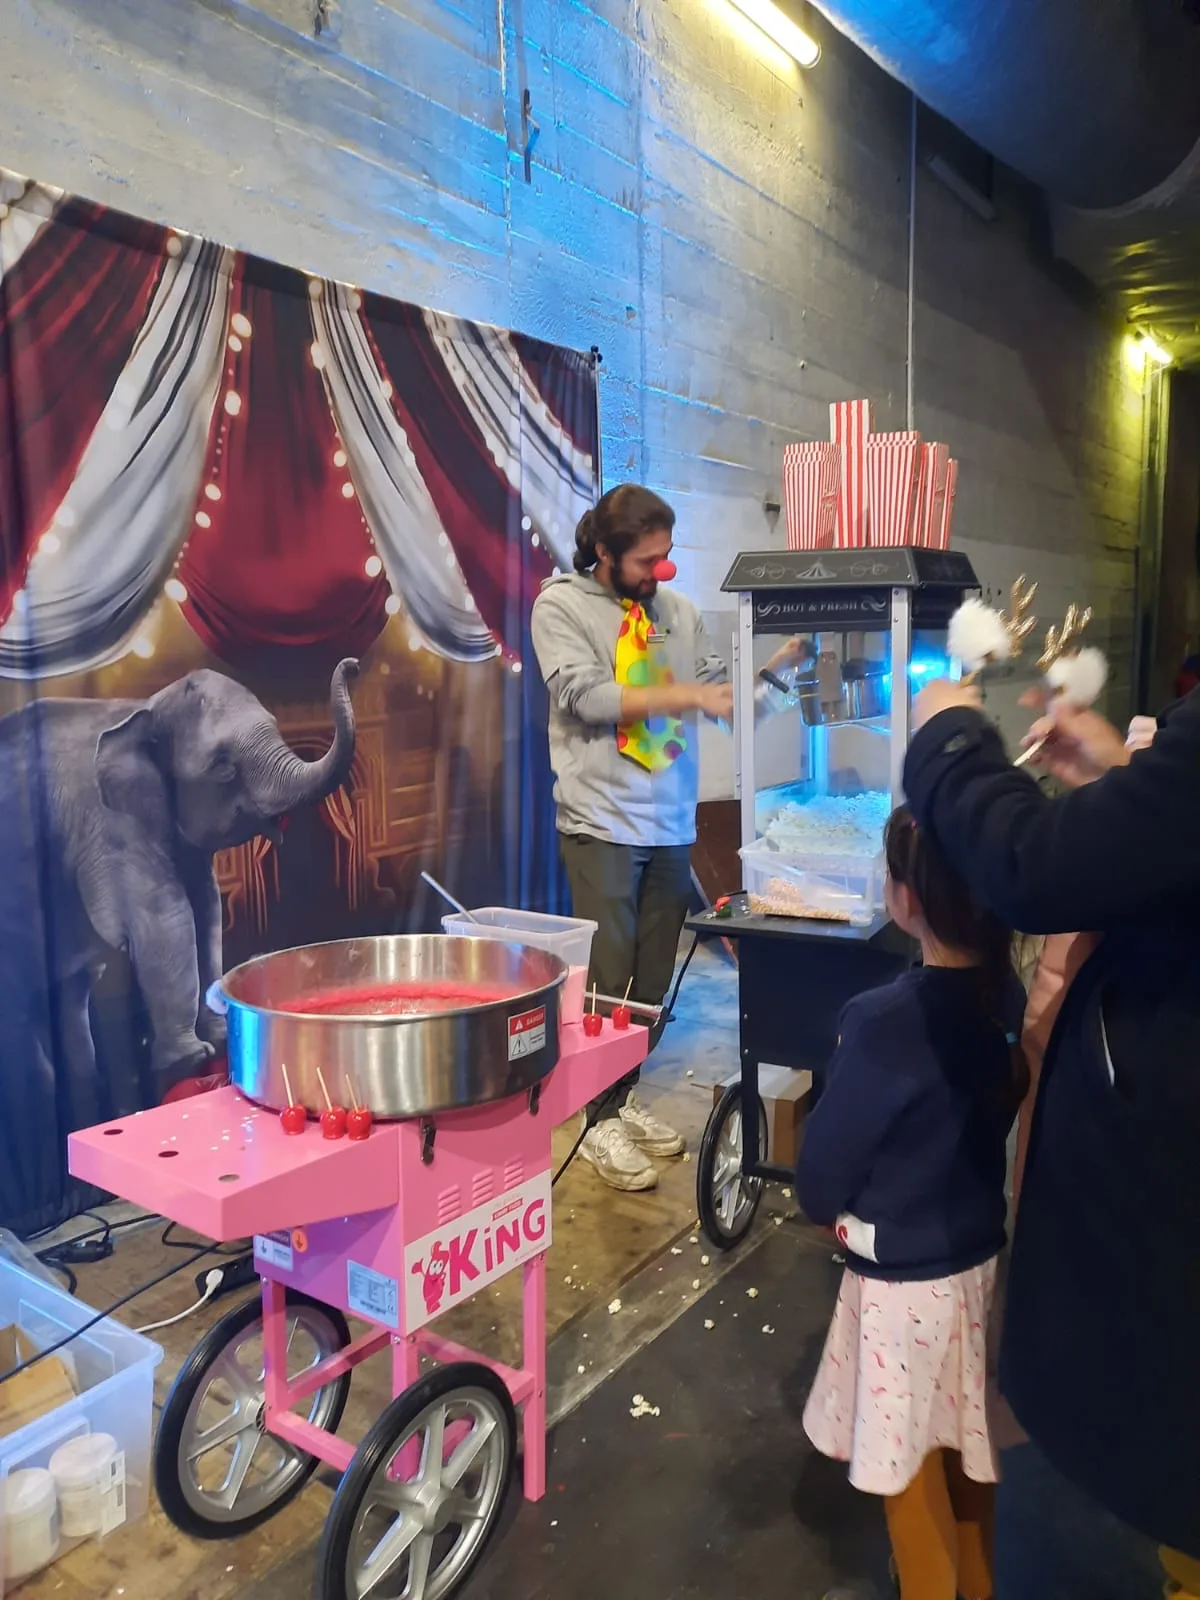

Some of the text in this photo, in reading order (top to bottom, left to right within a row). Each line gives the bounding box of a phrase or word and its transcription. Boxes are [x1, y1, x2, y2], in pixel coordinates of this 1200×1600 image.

[782, 600, 858, 612] HOT & FRESH
